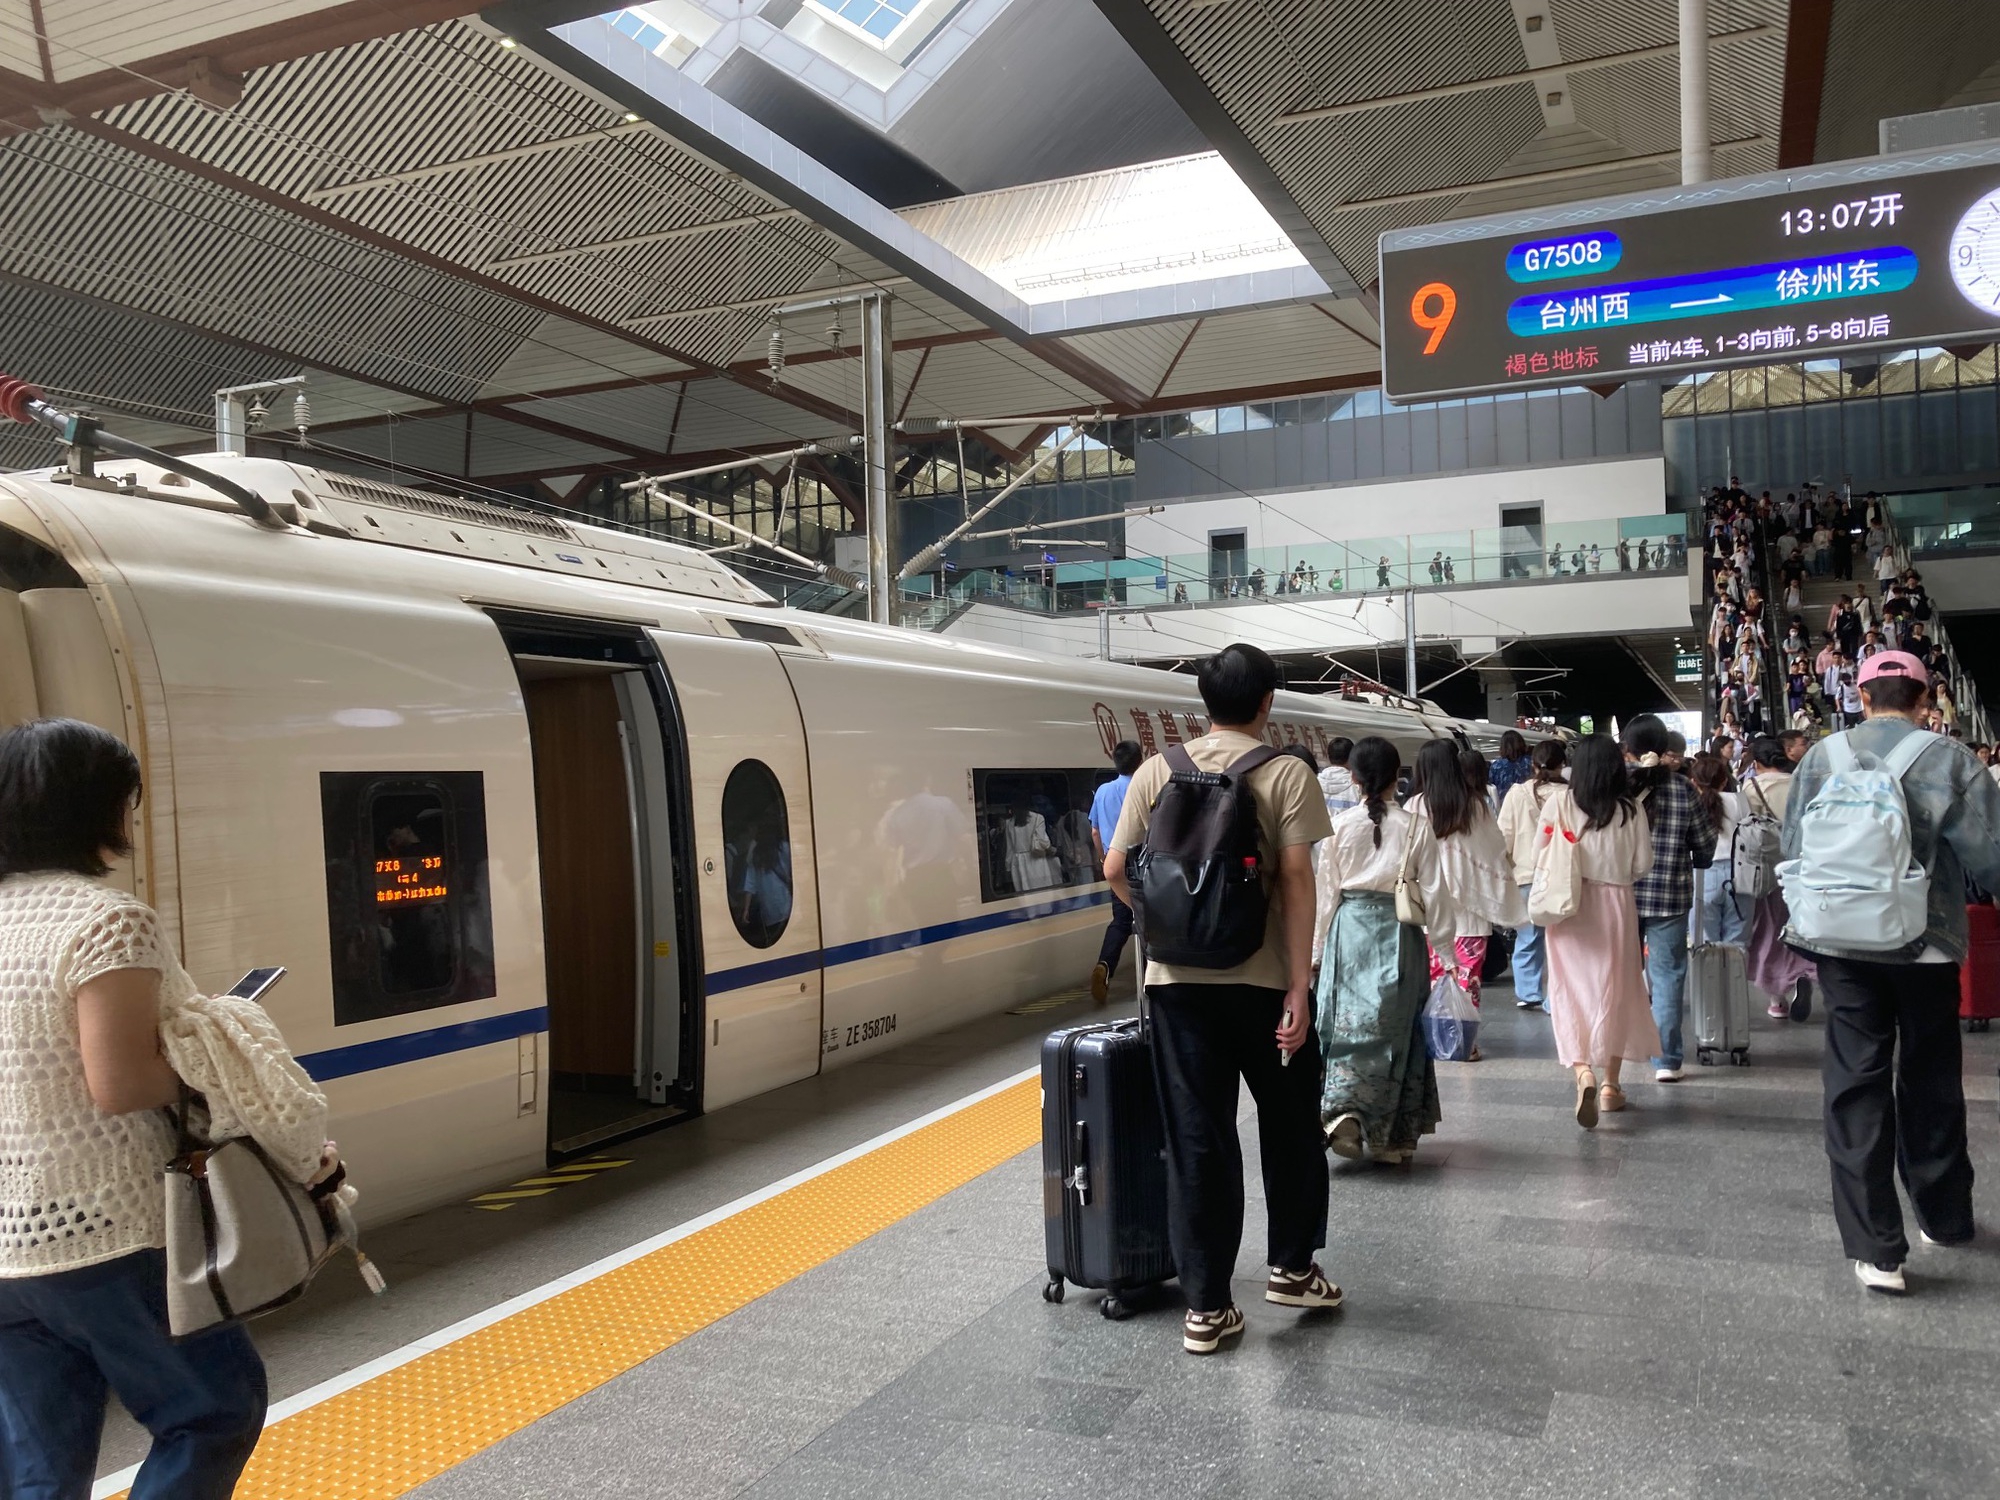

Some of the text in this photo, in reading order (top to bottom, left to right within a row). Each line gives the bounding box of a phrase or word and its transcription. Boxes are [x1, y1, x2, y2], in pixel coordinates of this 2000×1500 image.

[1780, 192, 1904, 236] 13:07开
[1524, 239, 1602, 271] G7508
[1957, 244, 1974, 267] 9
[1776, 258, 1881, 300] 徐州东
[1410, 281, 1457, 355] 9
[1539, 291, 1631, 330] 台州西
[1504, 345, 1599, 378] 褐色地标
[845, 1024, 860, 1047] ZE
[861, 1013, 897, 1042] 358704
